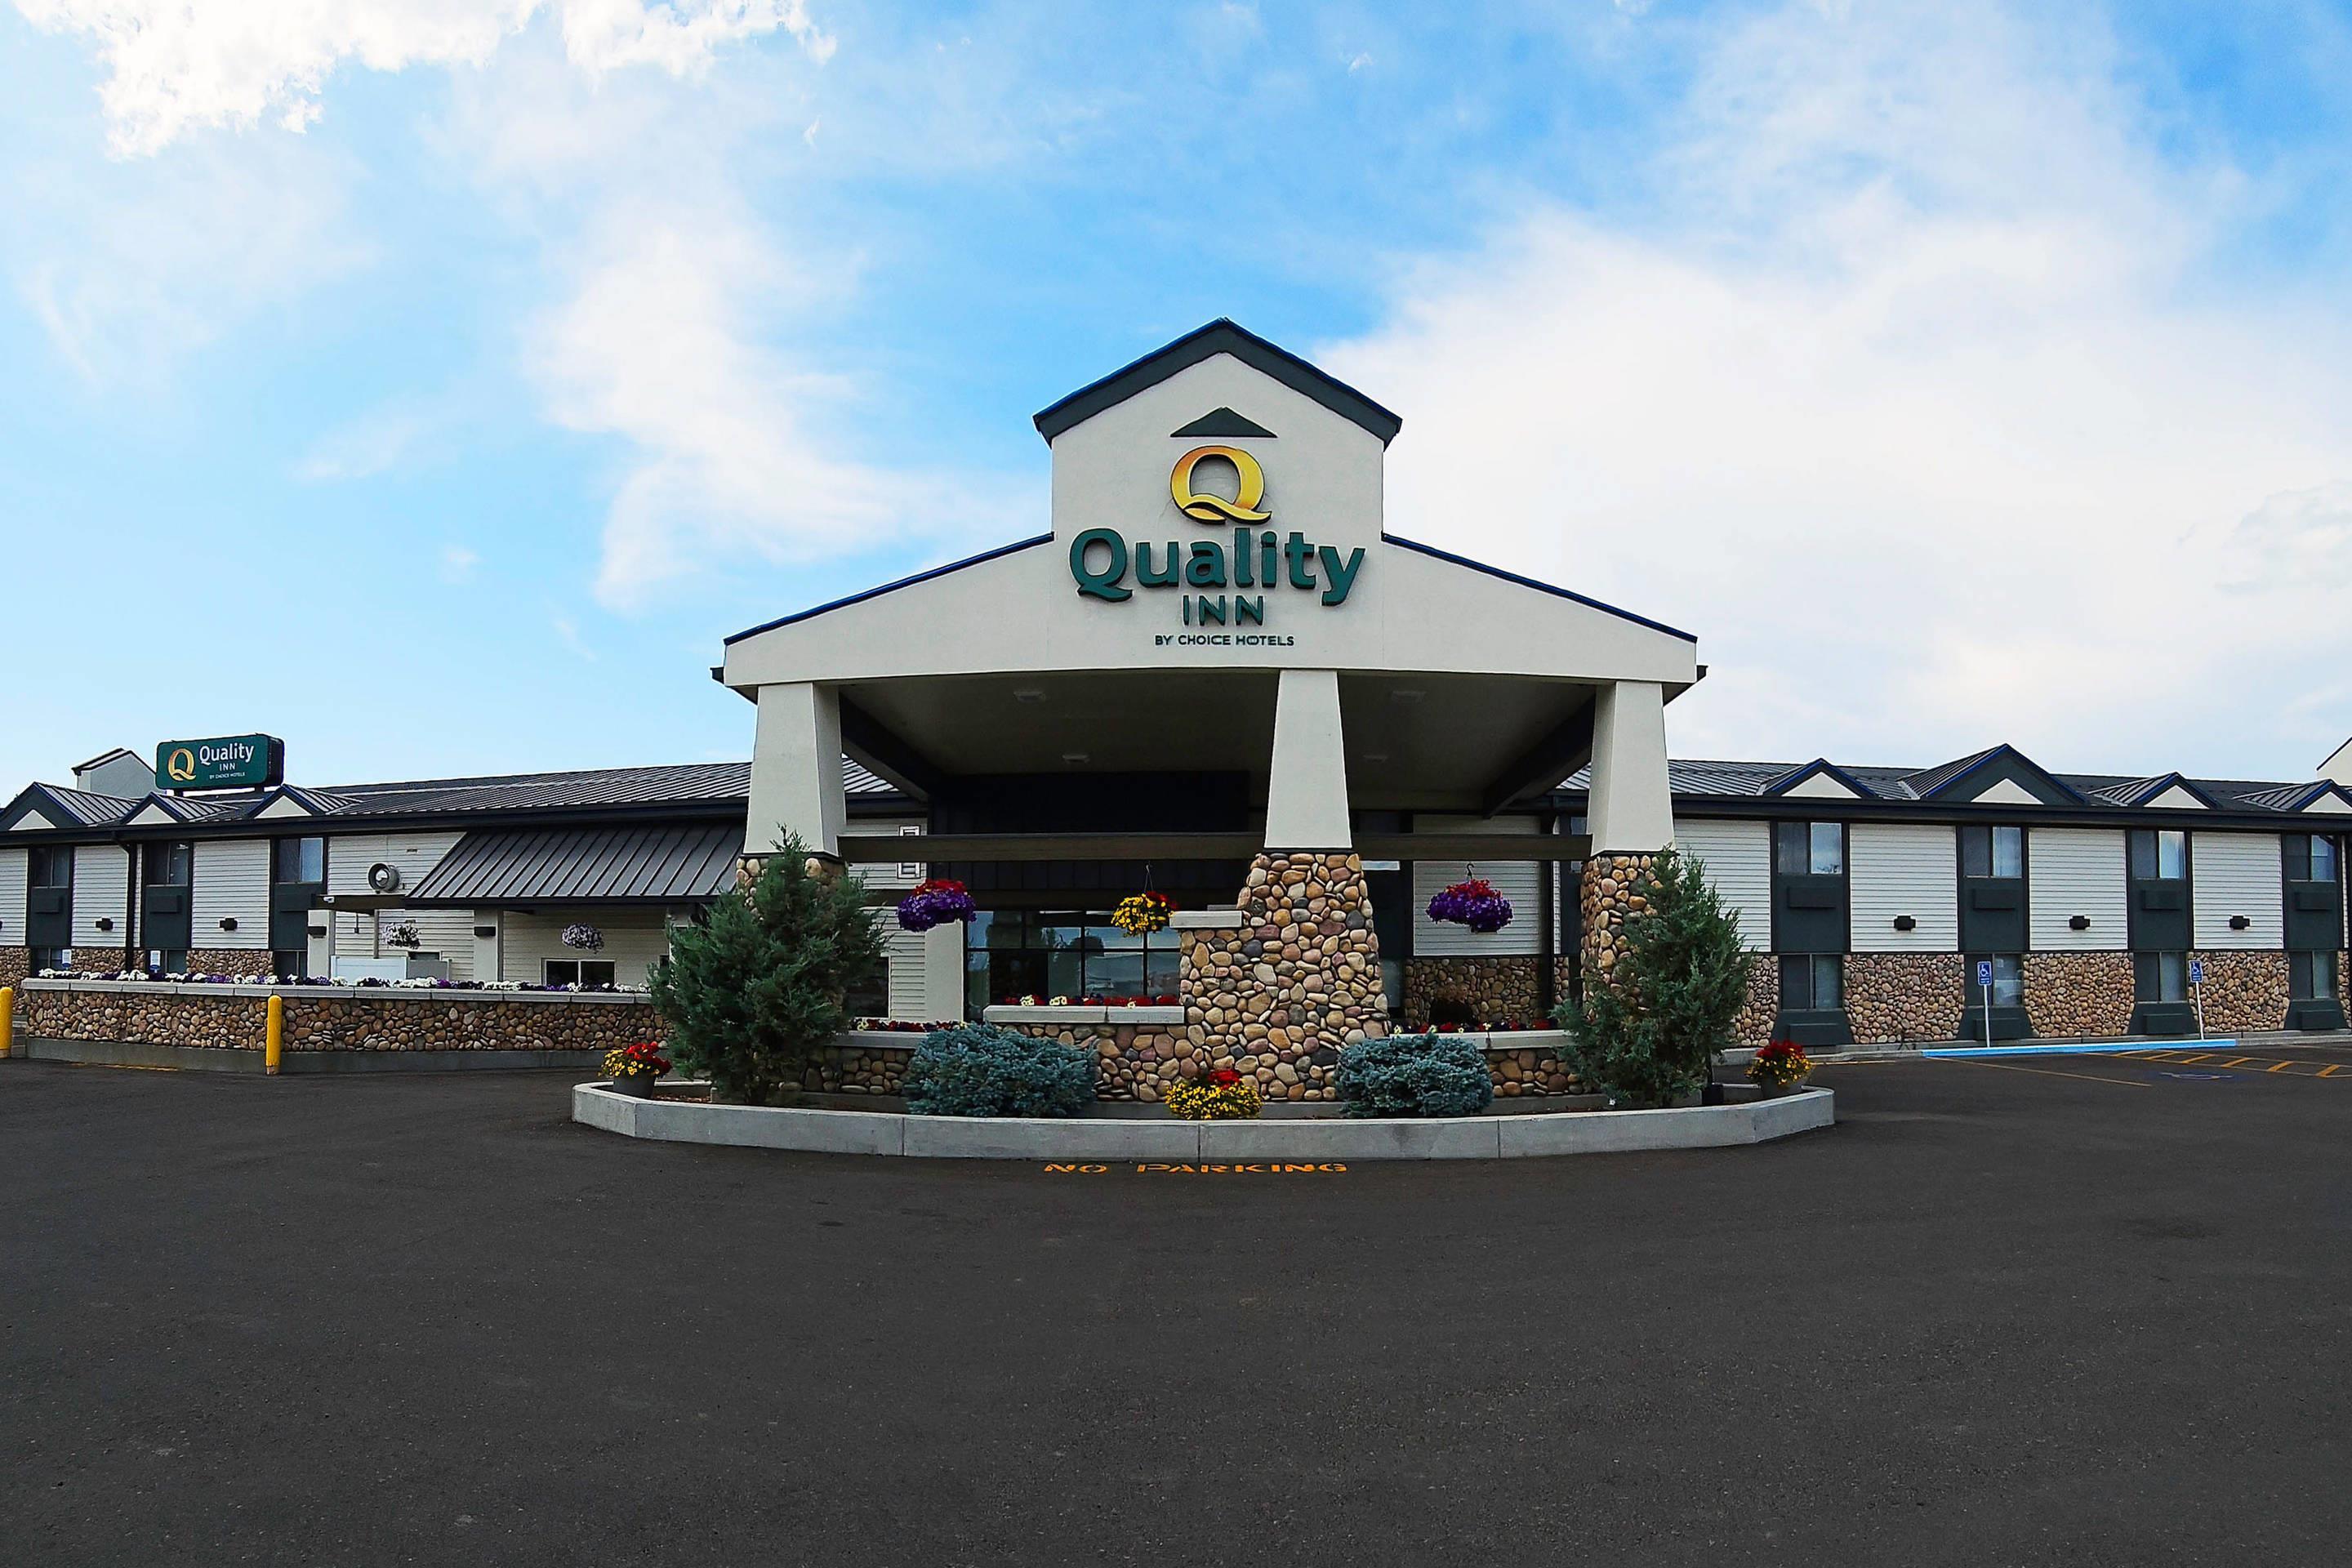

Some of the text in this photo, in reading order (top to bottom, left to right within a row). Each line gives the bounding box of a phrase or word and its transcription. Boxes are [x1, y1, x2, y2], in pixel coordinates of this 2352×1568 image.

[1169, 444, 1272, 525] Q
[1069, 528, 1366, 606] Quality
[1183, 595, 1263, 626] INN
[1155, 635, 1294, 646] BY CHOICE HOTELS
[167, 748, 197, 782] Q
[199, 742, 255, 766] Quality
[219, 762, 236, 772] INN
[1044, 1163, 1348, 1174] NO PARKING
